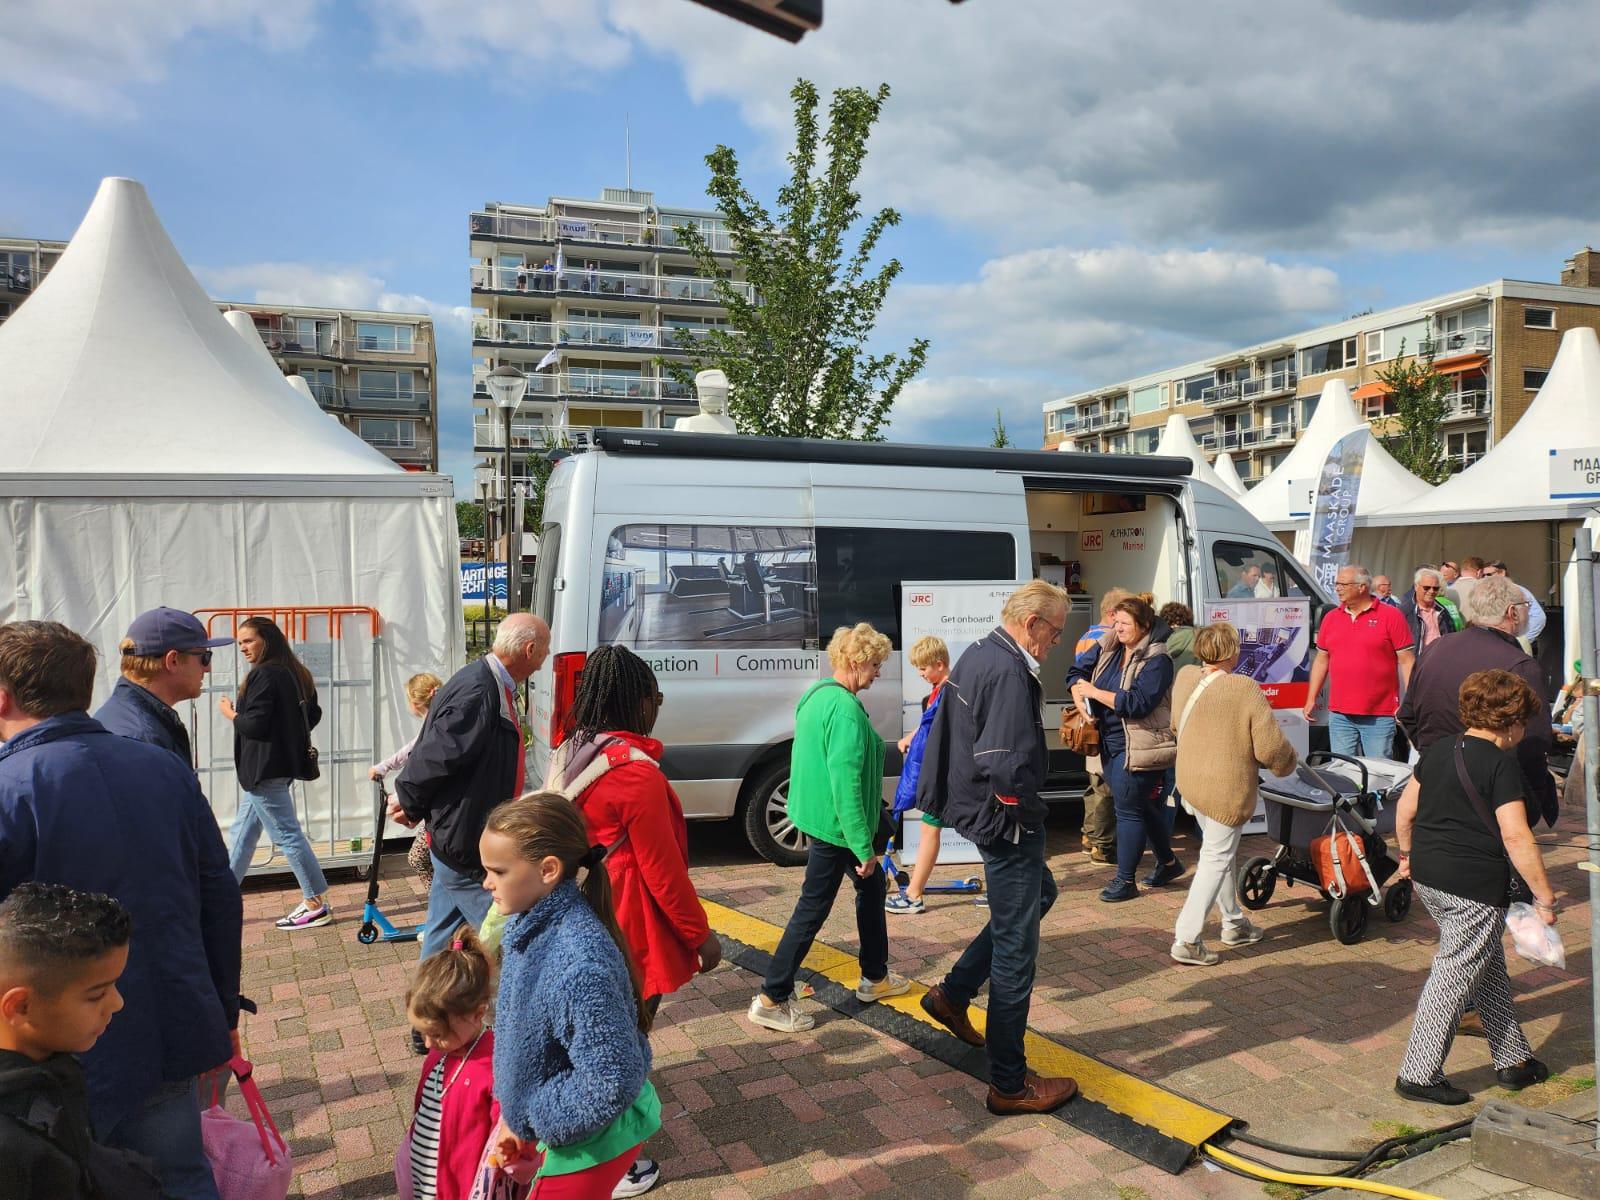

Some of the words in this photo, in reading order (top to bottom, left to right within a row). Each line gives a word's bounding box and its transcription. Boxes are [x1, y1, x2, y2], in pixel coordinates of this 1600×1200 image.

[1322, 467, 1345, 559] MAASKADE
[1337, 490, 1352, 537] GROUP
[1083, 534, 1102, 547] JRC
[1122, 541, 1145, 551] Marine
[911, 594, 932, 604] JRC
[940, 615, 956, 624] Get
[1211, 611, 1228, 619] JRC
